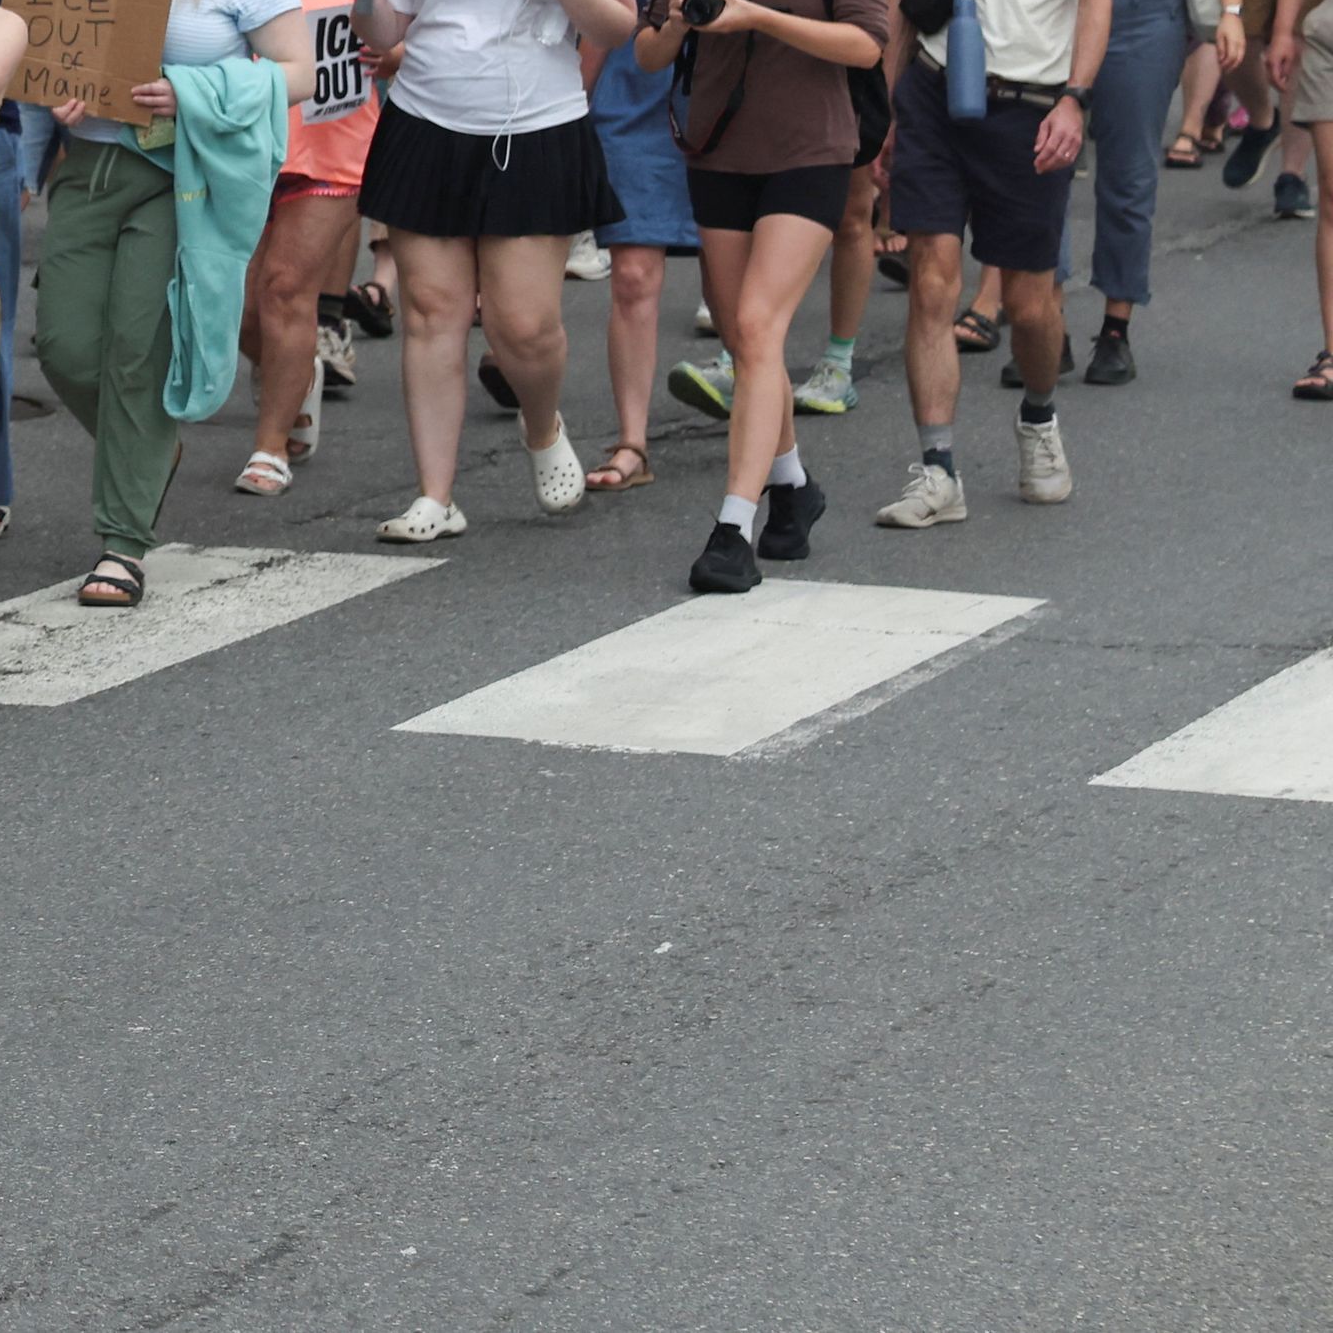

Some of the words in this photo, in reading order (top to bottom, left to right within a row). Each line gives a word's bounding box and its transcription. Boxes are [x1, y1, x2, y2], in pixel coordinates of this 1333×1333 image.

[27, 16, 116, 47] OUT
[24, 67, 112, 106] Maine
[313, 59, 362, 105] OUT
